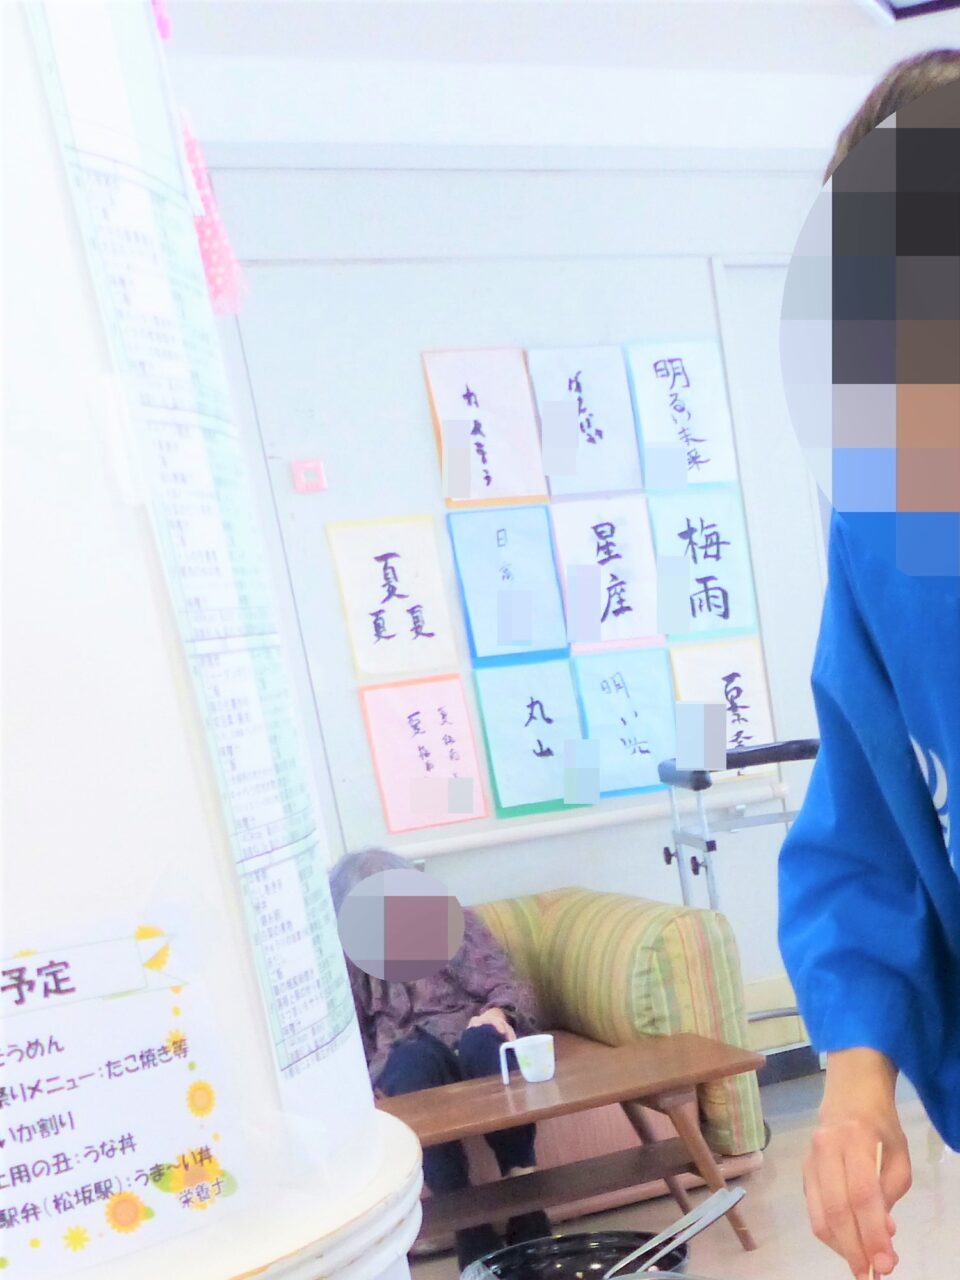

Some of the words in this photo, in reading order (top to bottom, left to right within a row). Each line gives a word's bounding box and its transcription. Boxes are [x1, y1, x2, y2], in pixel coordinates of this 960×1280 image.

[590, 520, 635, 624] 星座
[677, 517, 732, 621] 梅雨
[0, 960, 77, 1006] 予定
